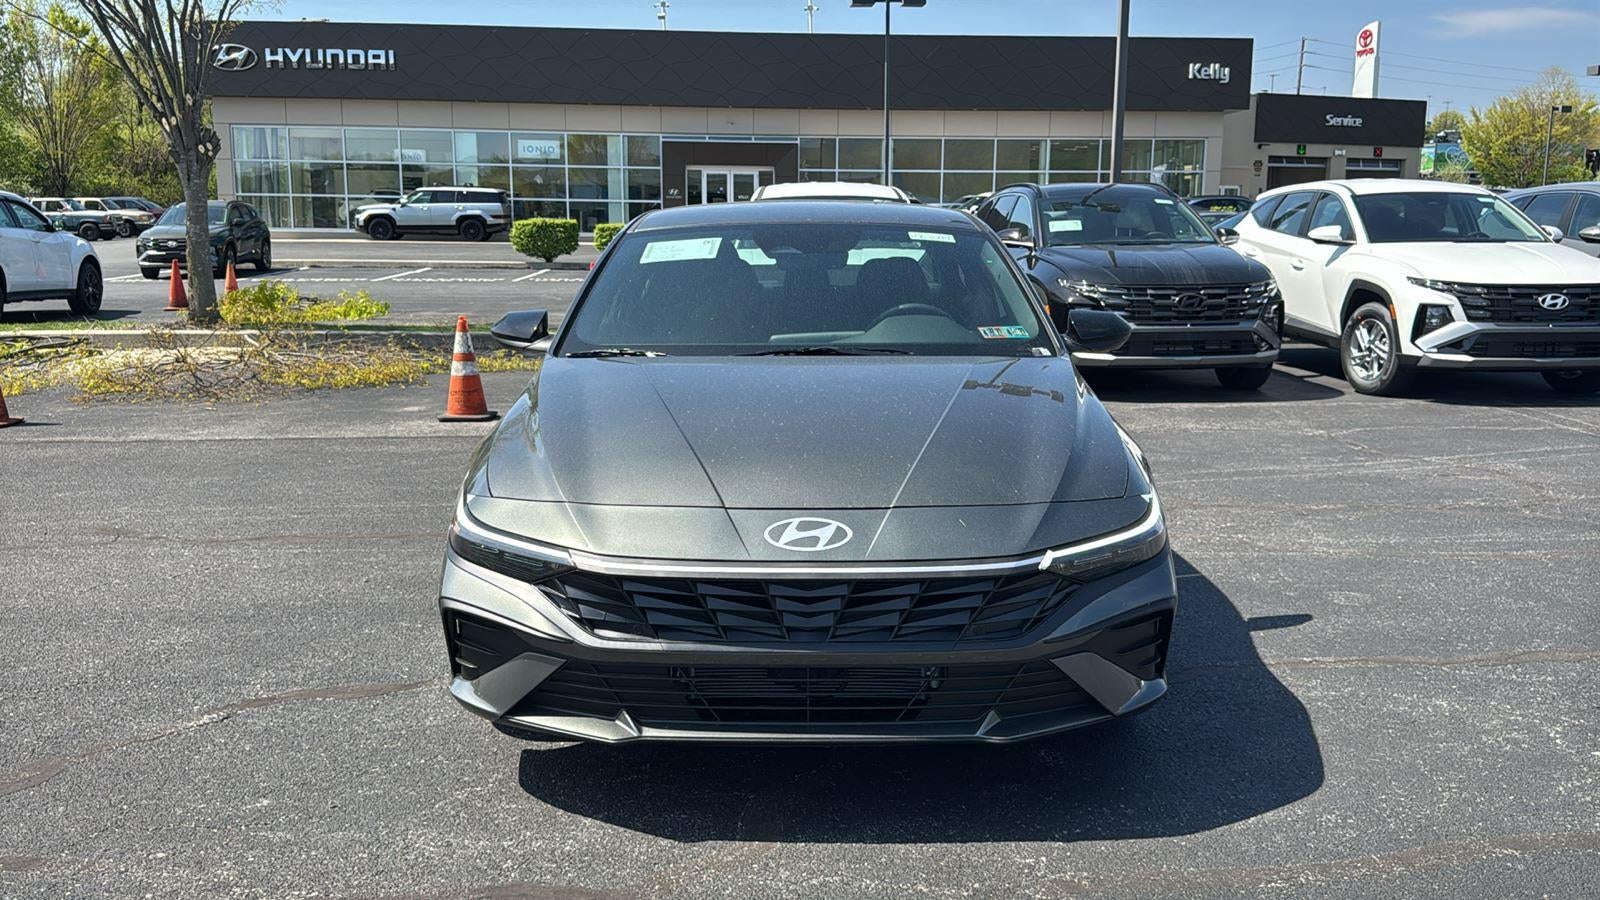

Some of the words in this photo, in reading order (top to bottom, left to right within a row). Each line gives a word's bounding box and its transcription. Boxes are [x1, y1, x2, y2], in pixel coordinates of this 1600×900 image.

[264, 47, 396, 71] HYUNDAI
[1188, 62, 1231, 84] Kelly
[1325, 114, 1363, 127] Service
